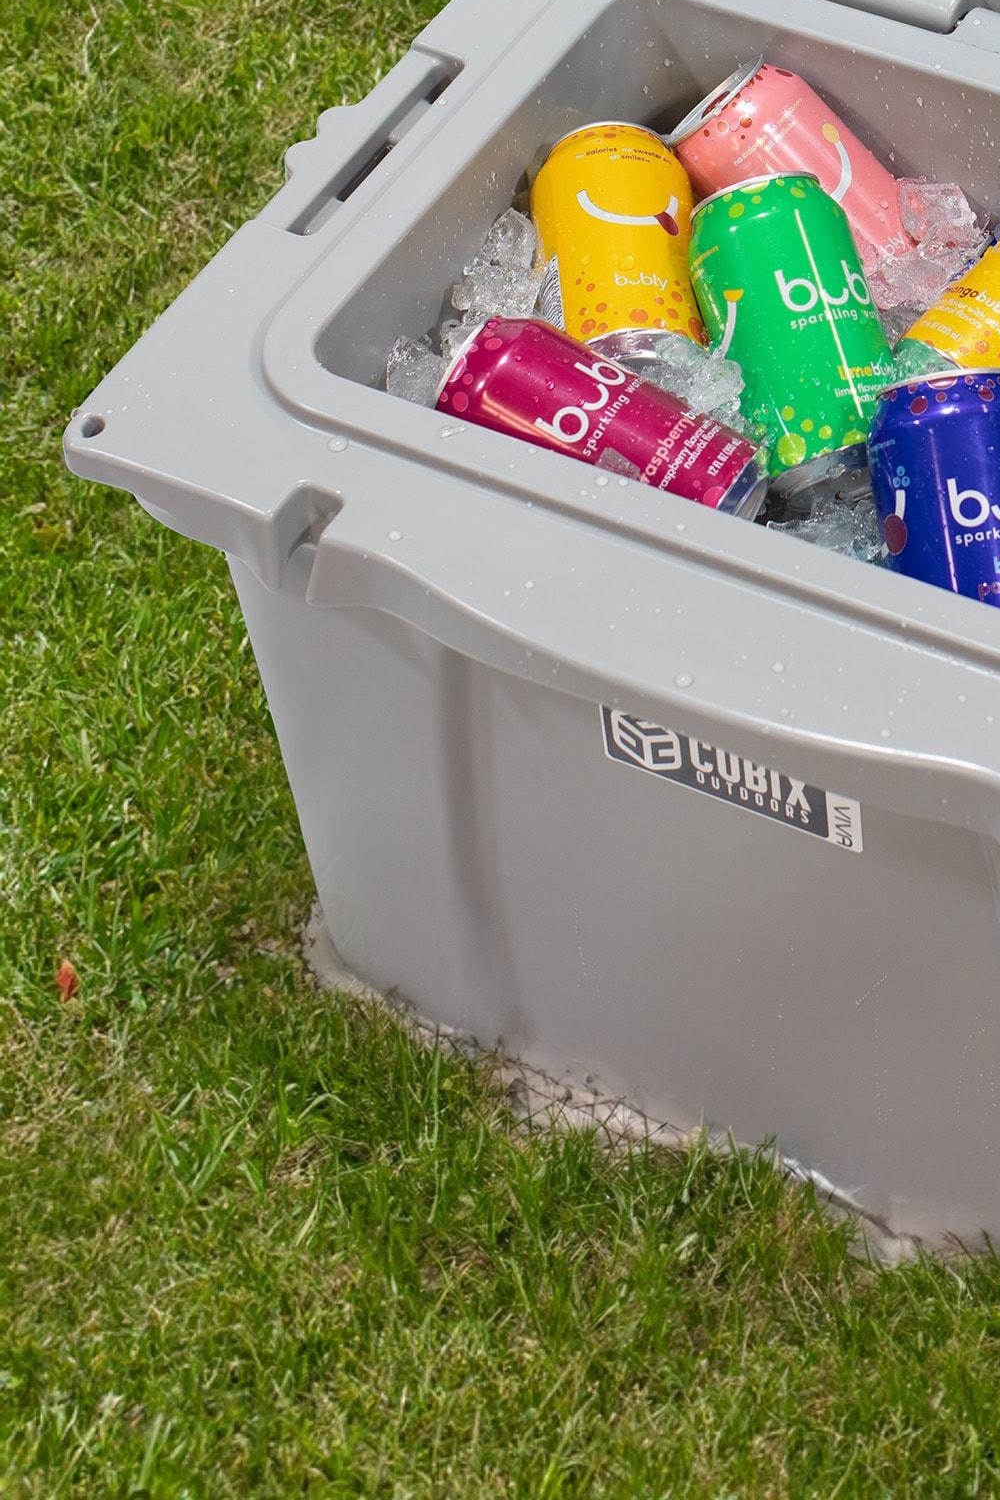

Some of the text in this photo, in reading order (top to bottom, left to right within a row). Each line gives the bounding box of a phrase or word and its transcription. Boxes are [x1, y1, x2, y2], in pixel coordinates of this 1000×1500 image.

[614, 272, 668, 291] bubly
[582, 394, 630, 457] sparkling
[689, 736, 811, 813] CUBIX
[697, 771, 809, 824] OUTDOORS
[832, 806, 853, 848] VIVA
